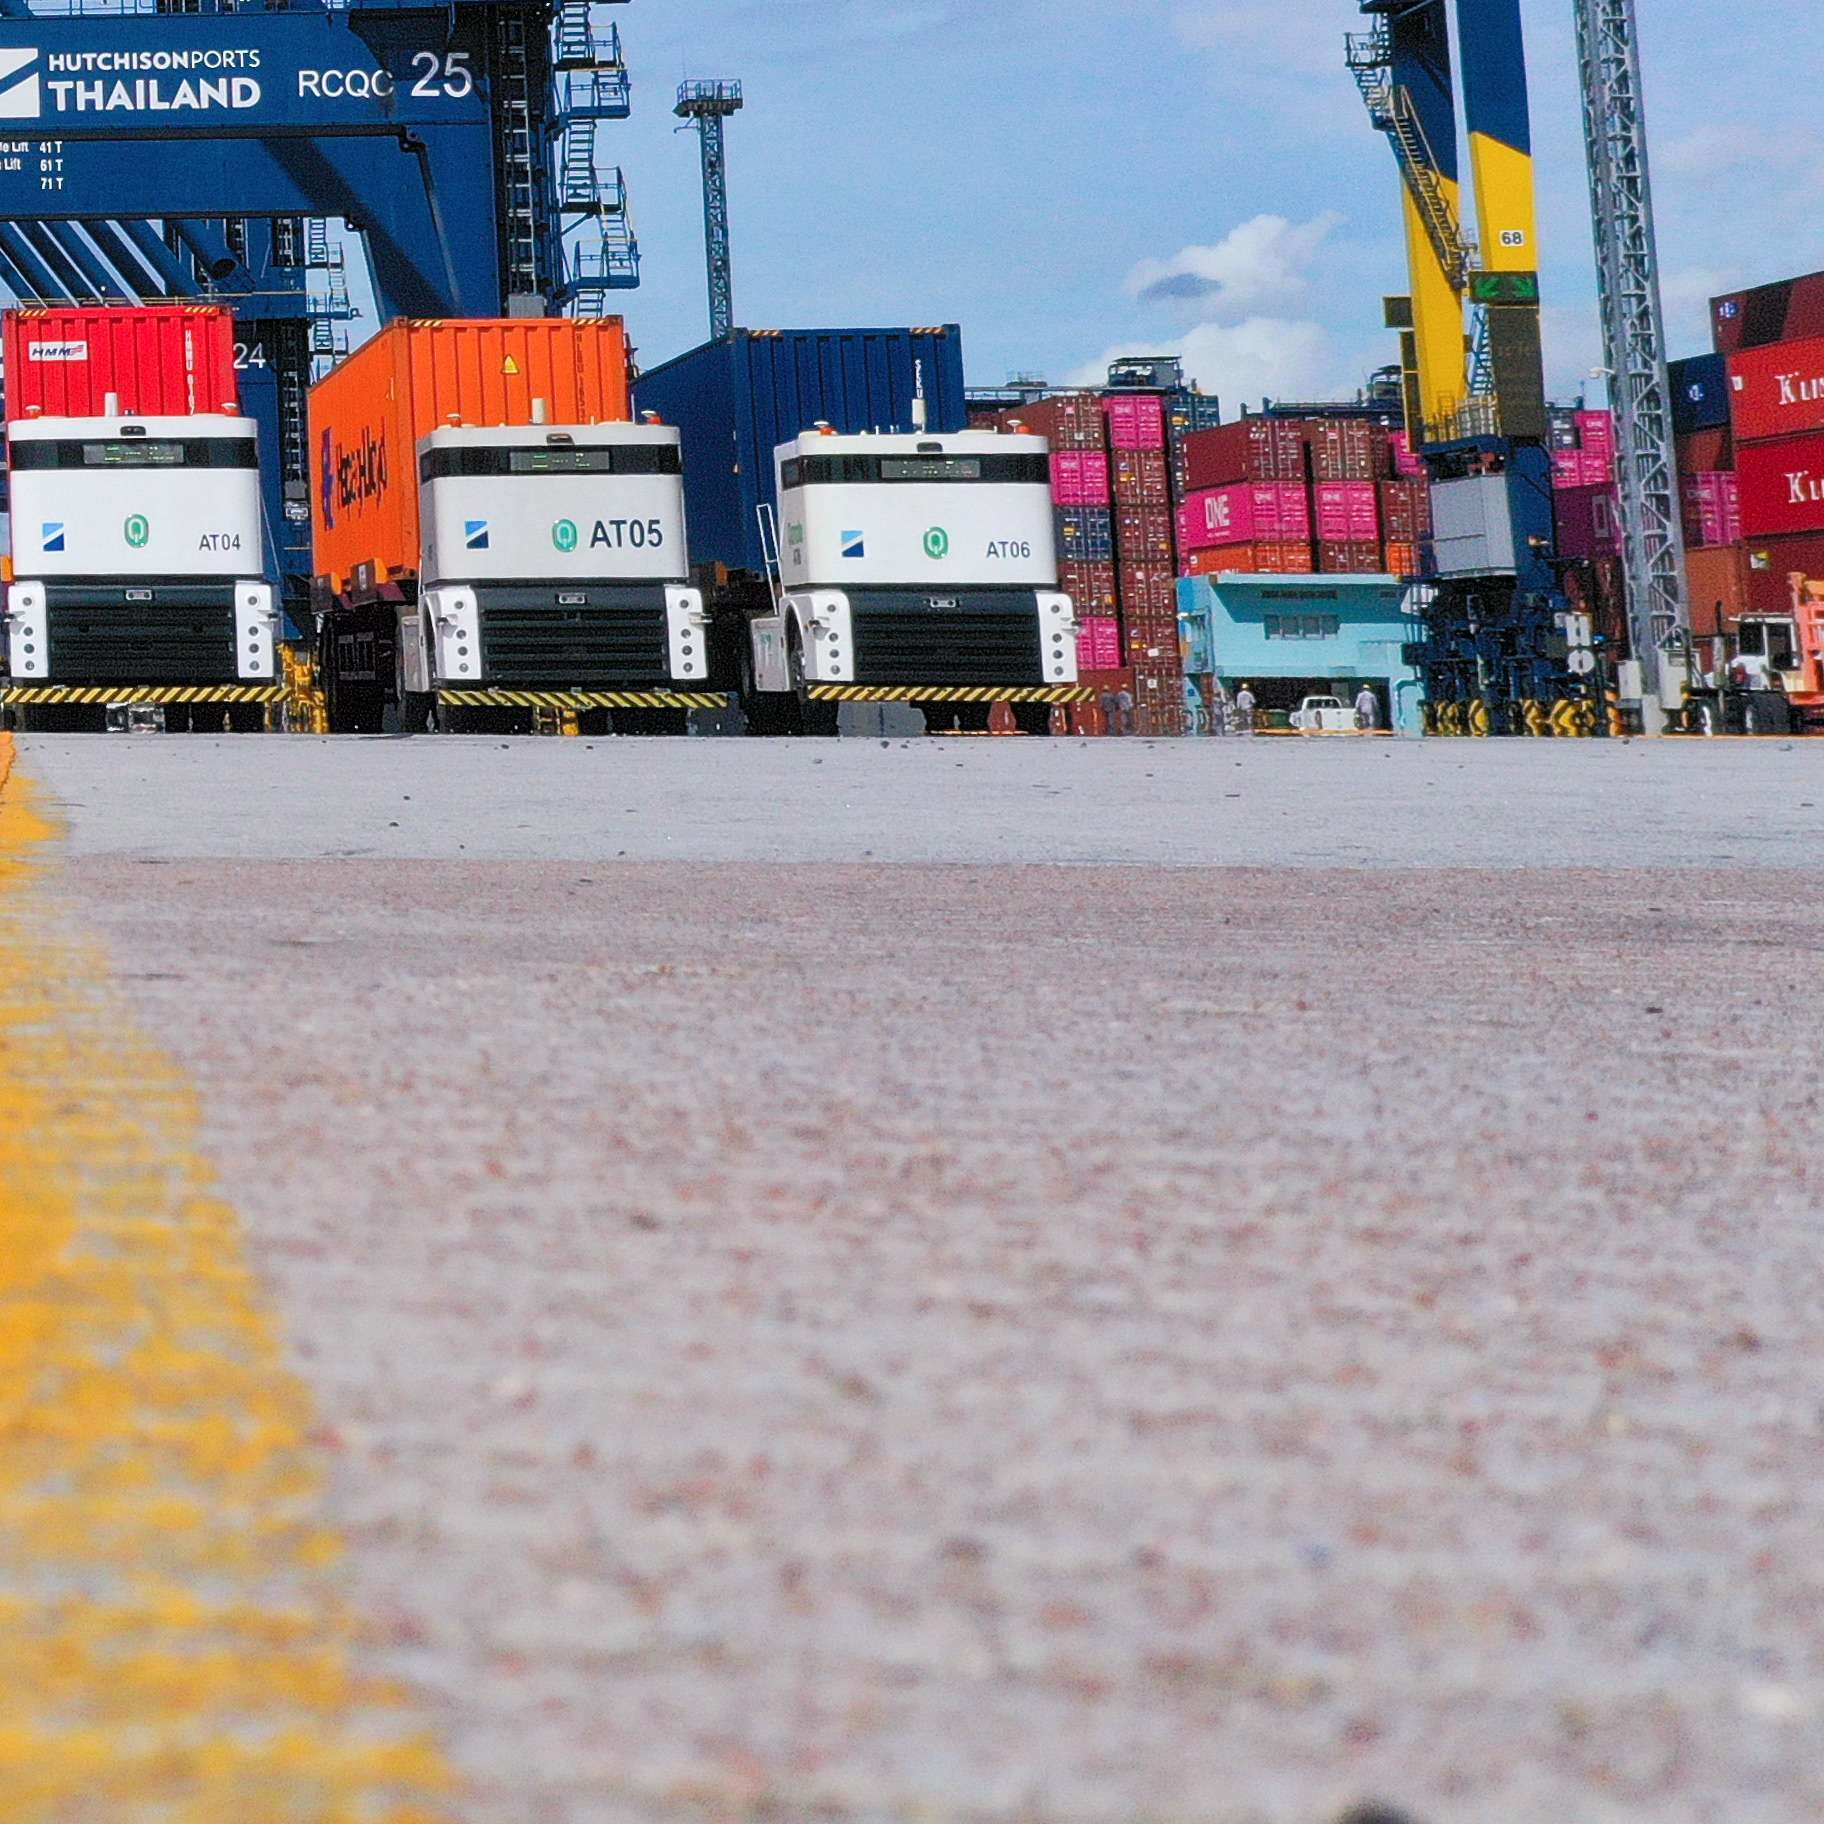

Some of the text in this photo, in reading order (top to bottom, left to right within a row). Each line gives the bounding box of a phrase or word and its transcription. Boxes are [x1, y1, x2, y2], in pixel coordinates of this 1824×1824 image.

[298, 51, 473, 99] RCQC 25
[47, 77, 262, 112] THAILAND
[39, 141, 52, 154] 41
[55, 140, 63, 154] T
[3, 157, 22, 172] Lift
[39, 158, 53, 172] 61
[54, 158, 64, 172] T
[40, 177, 53, 190] 71
[55, 177, 64, 190] T
[1501, 231, 1523, 245] 68
[232, 342, 266, 369] 24
[198, 533, 242, 552] AT04
[589, 518, 664, 549] AT05
[985, 540, 1031, 559] AT06
